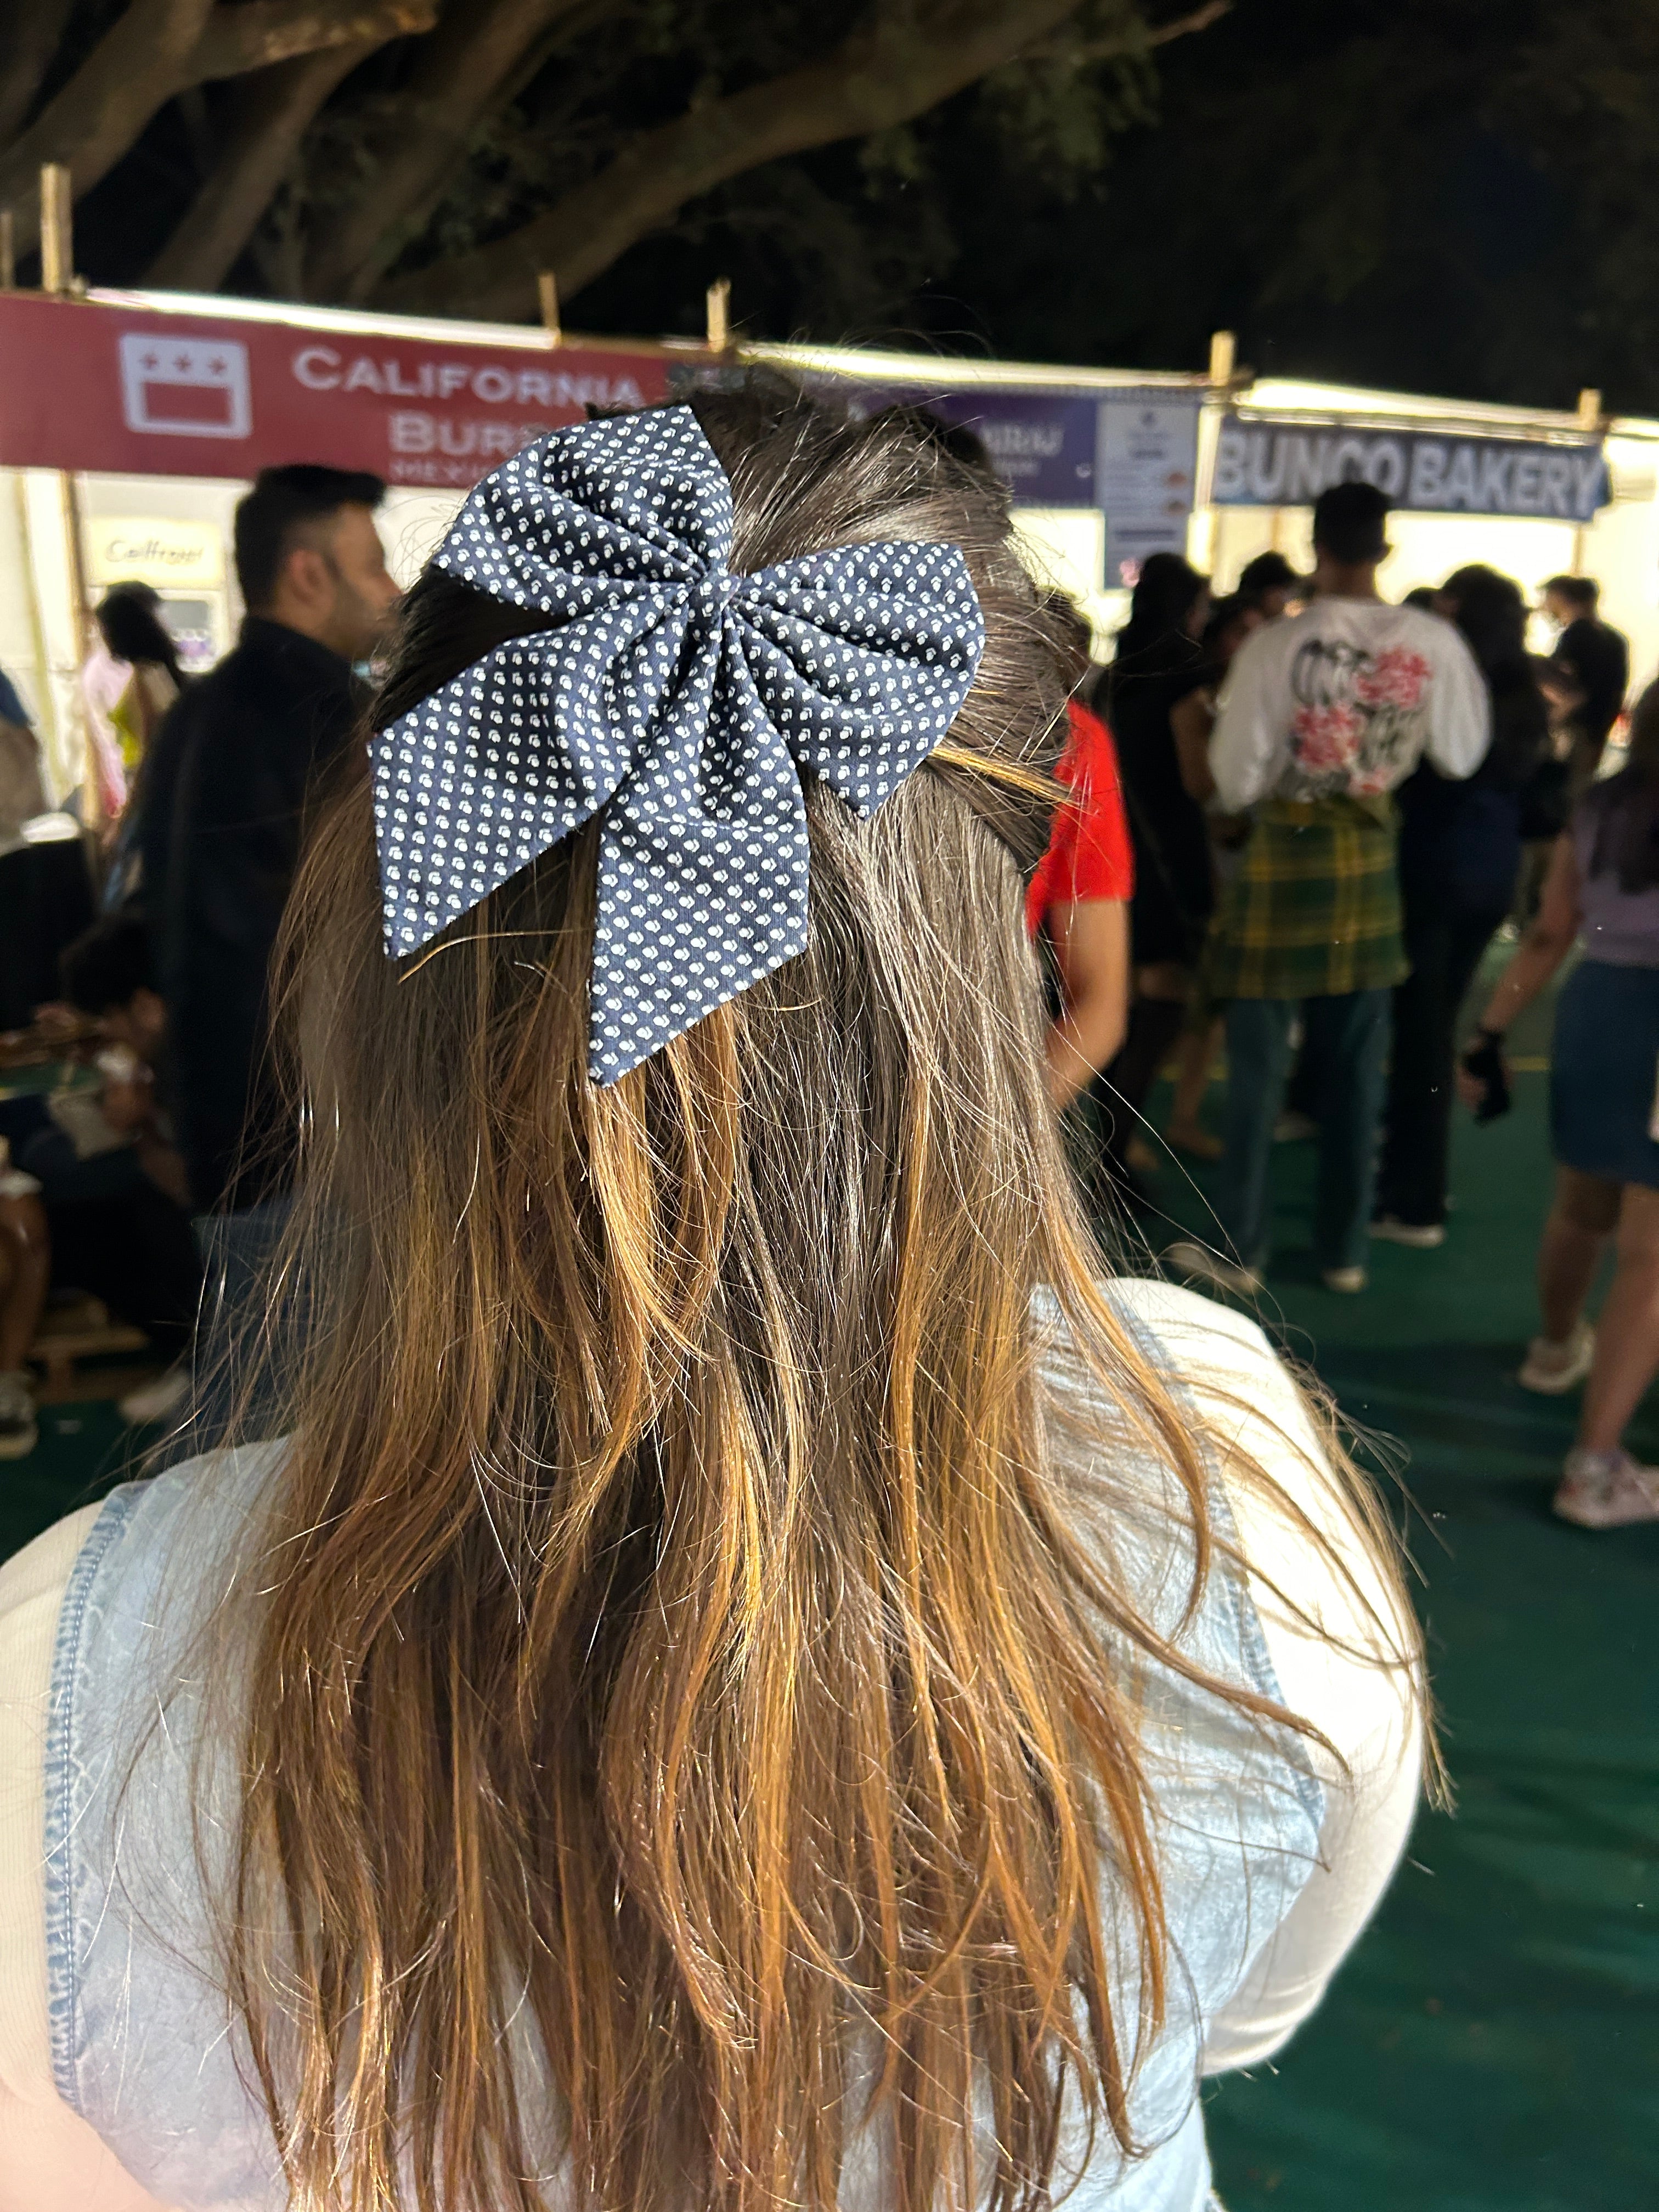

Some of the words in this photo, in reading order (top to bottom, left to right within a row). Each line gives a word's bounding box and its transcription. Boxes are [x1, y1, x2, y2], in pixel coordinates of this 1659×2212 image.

[291, 345, 646, 406] CALIFORNIA
[390, 410, 533, 457] BUR
[1408, 443, 1602, 515] BAKERY
